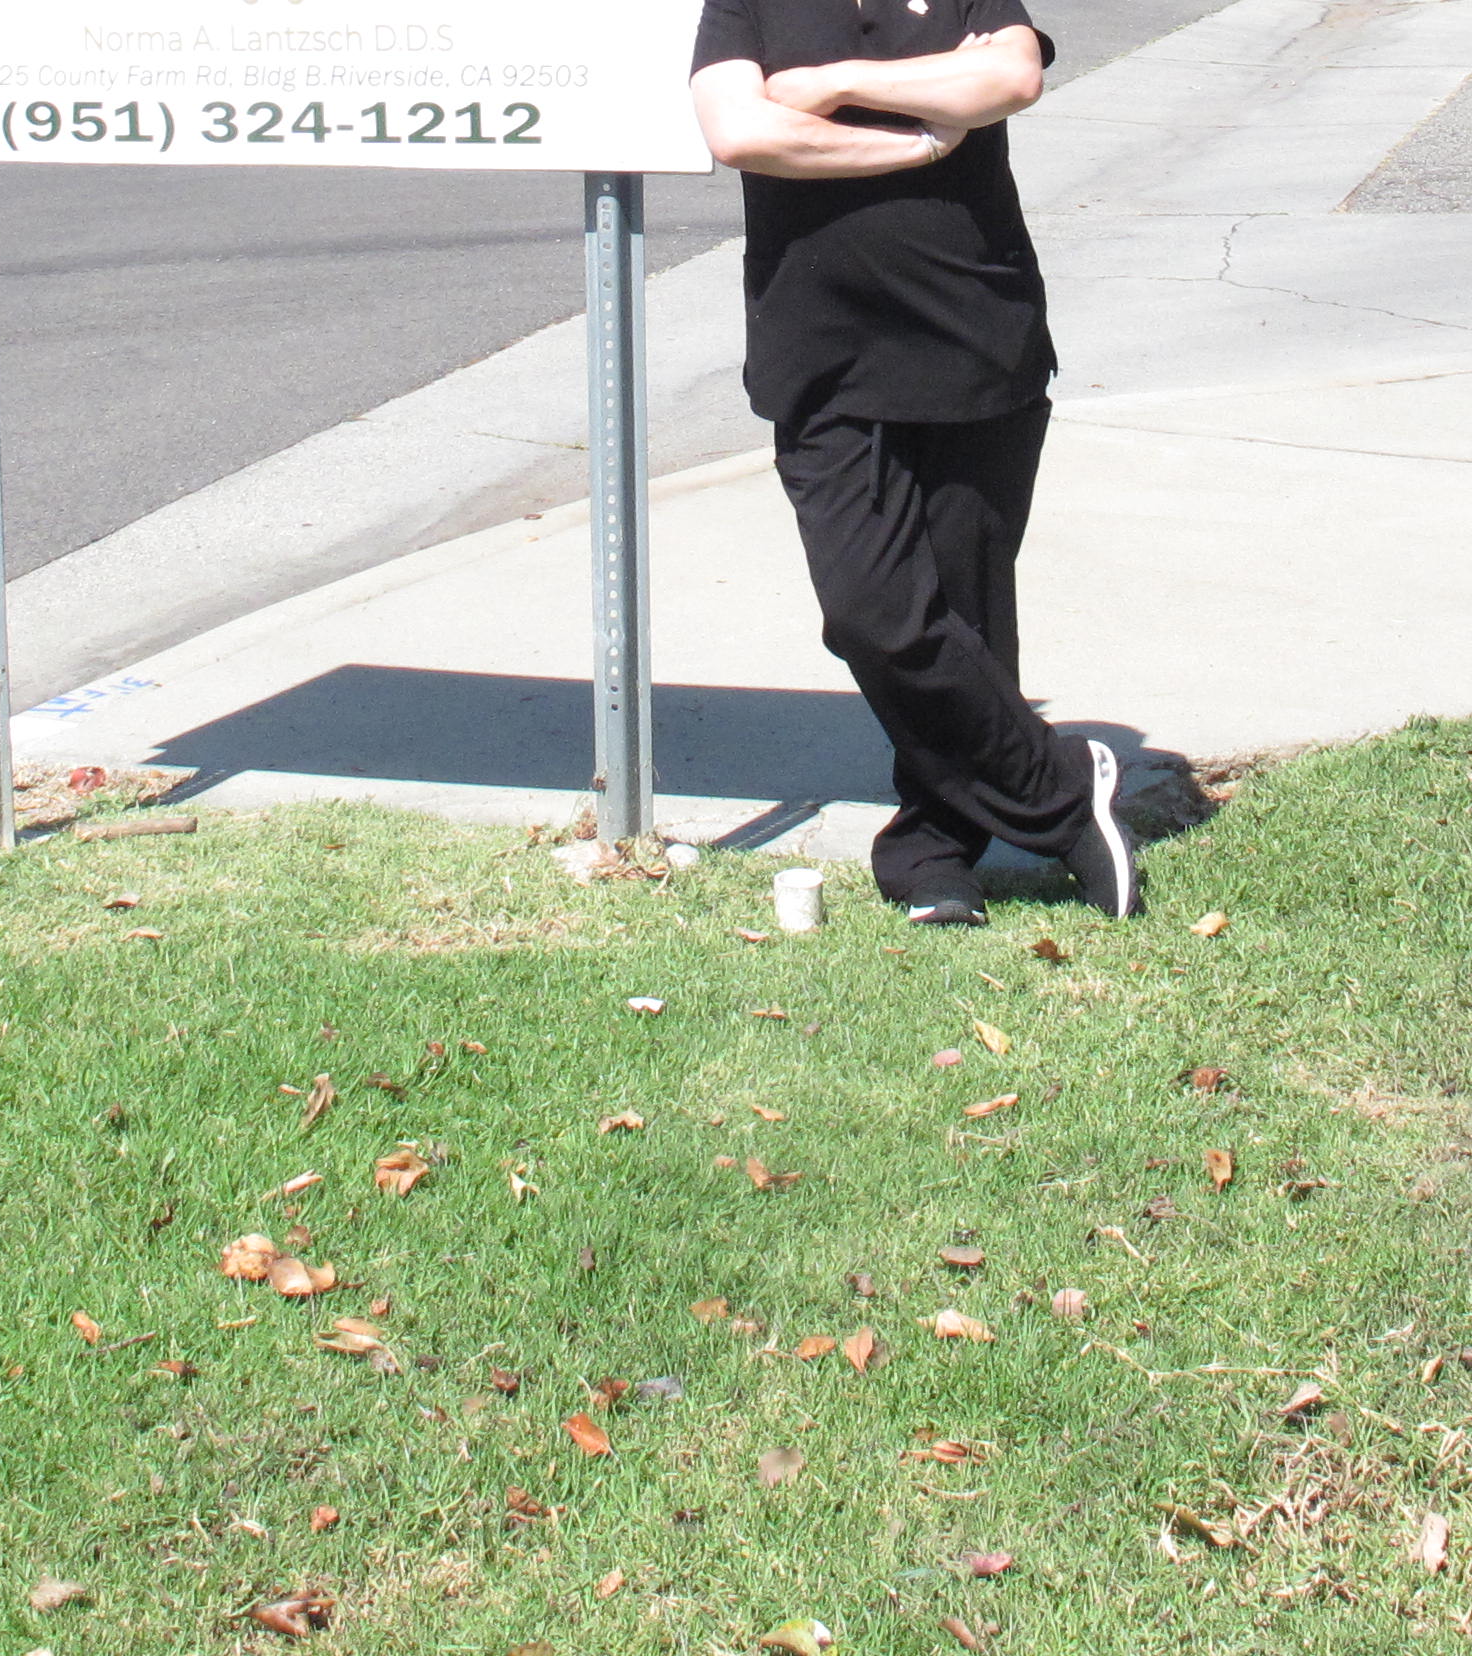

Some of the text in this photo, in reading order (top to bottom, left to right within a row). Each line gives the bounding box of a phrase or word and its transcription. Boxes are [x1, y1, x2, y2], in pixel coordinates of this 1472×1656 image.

[82, 24, 455, 52] Norma A. Lantzsch D.D.S
[38, 64, 118, 92] County
[126, 65, 187, 87] Farm
[244, 65, 297, 92] Bldg
[460, 65, 493, 87] CA
[503, 64, 590, 88] 92503
[2, 101, 543, 153] (951) 324-1212
